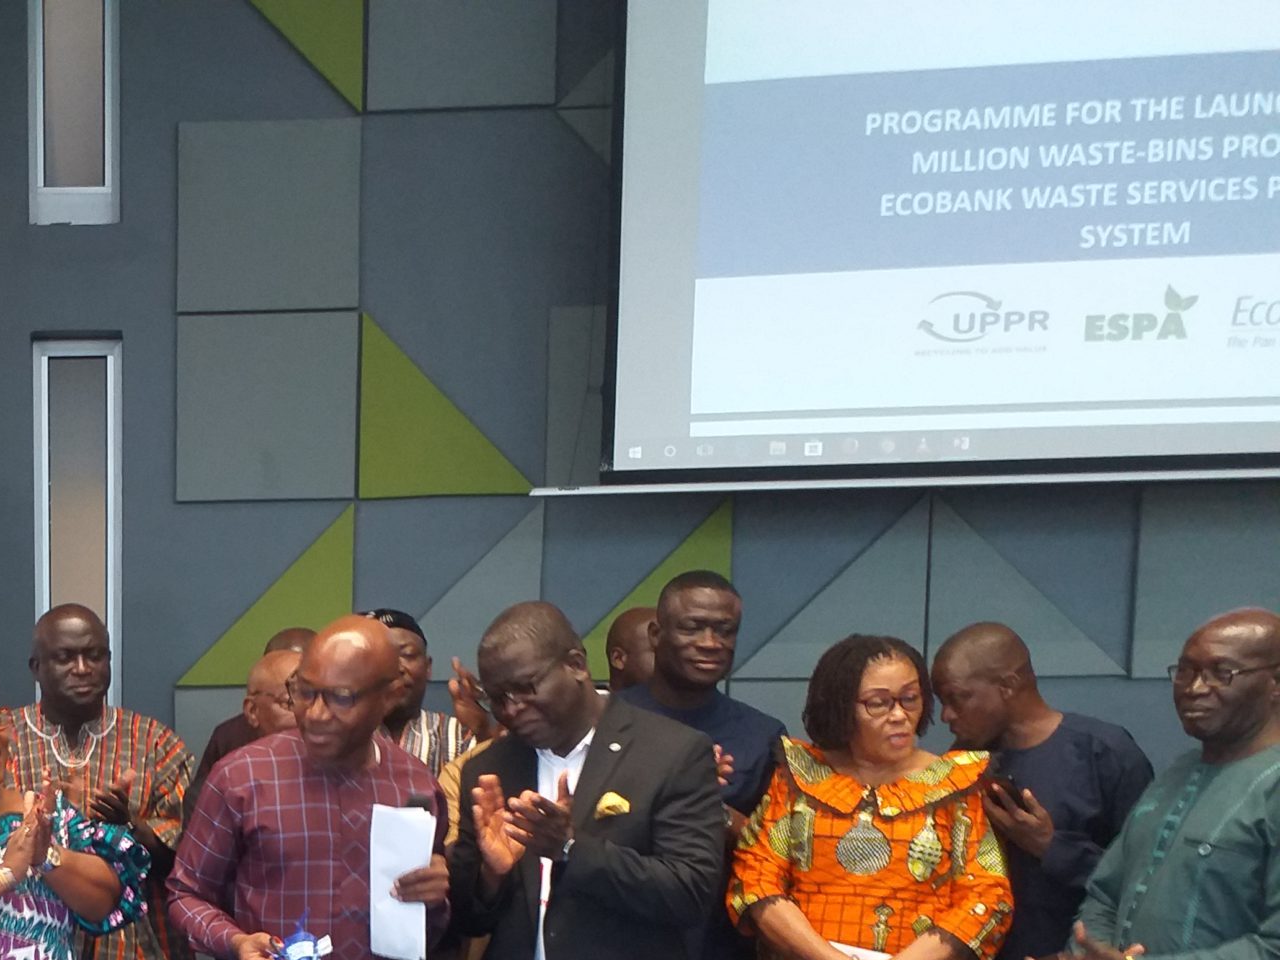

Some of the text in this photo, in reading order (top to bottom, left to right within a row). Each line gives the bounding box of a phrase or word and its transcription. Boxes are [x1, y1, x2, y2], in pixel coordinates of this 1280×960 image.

[865, 102, 1058, 137] PROGRAMME
[1065, 99, 1123, 126] FOR
[1130, 95, 1185, 122] THE
[912, 133, 1280, 176] MILLION WASTE-BINS PRO
[879, 187, 1012, 218] ECOBANK
[1021, 181, 1119, 212] WASTE
[1126, 175, 1259, 206] SERVICES
[1080, 219, 1191, 250] SYSTEM
[952, 309, 1050, 335] UPPR
[1083, 310, 1188, 342] ESPA
